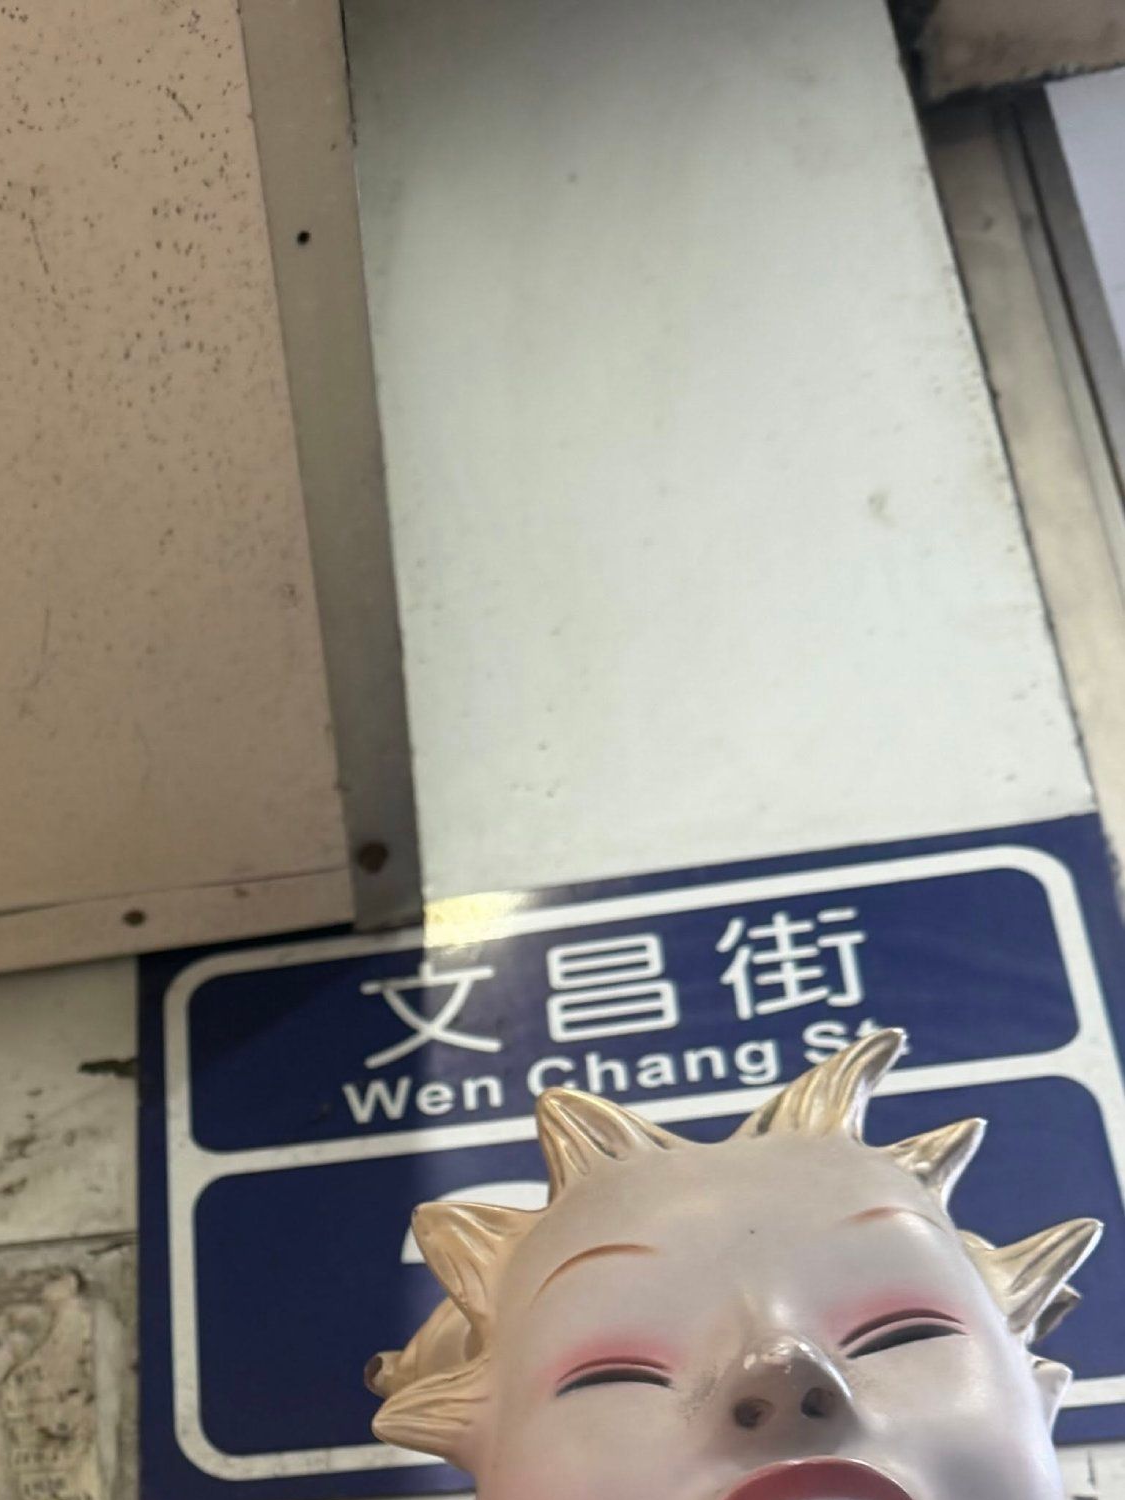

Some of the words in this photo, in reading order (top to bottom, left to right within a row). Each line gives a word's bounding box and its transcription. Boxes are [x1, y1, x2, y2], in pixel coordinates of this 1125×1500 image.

[359, 907, 867, 1070] 文昌街
[342, 1074, 503, 1125] Wen
[526, 1036, 778, 1097] Chang
